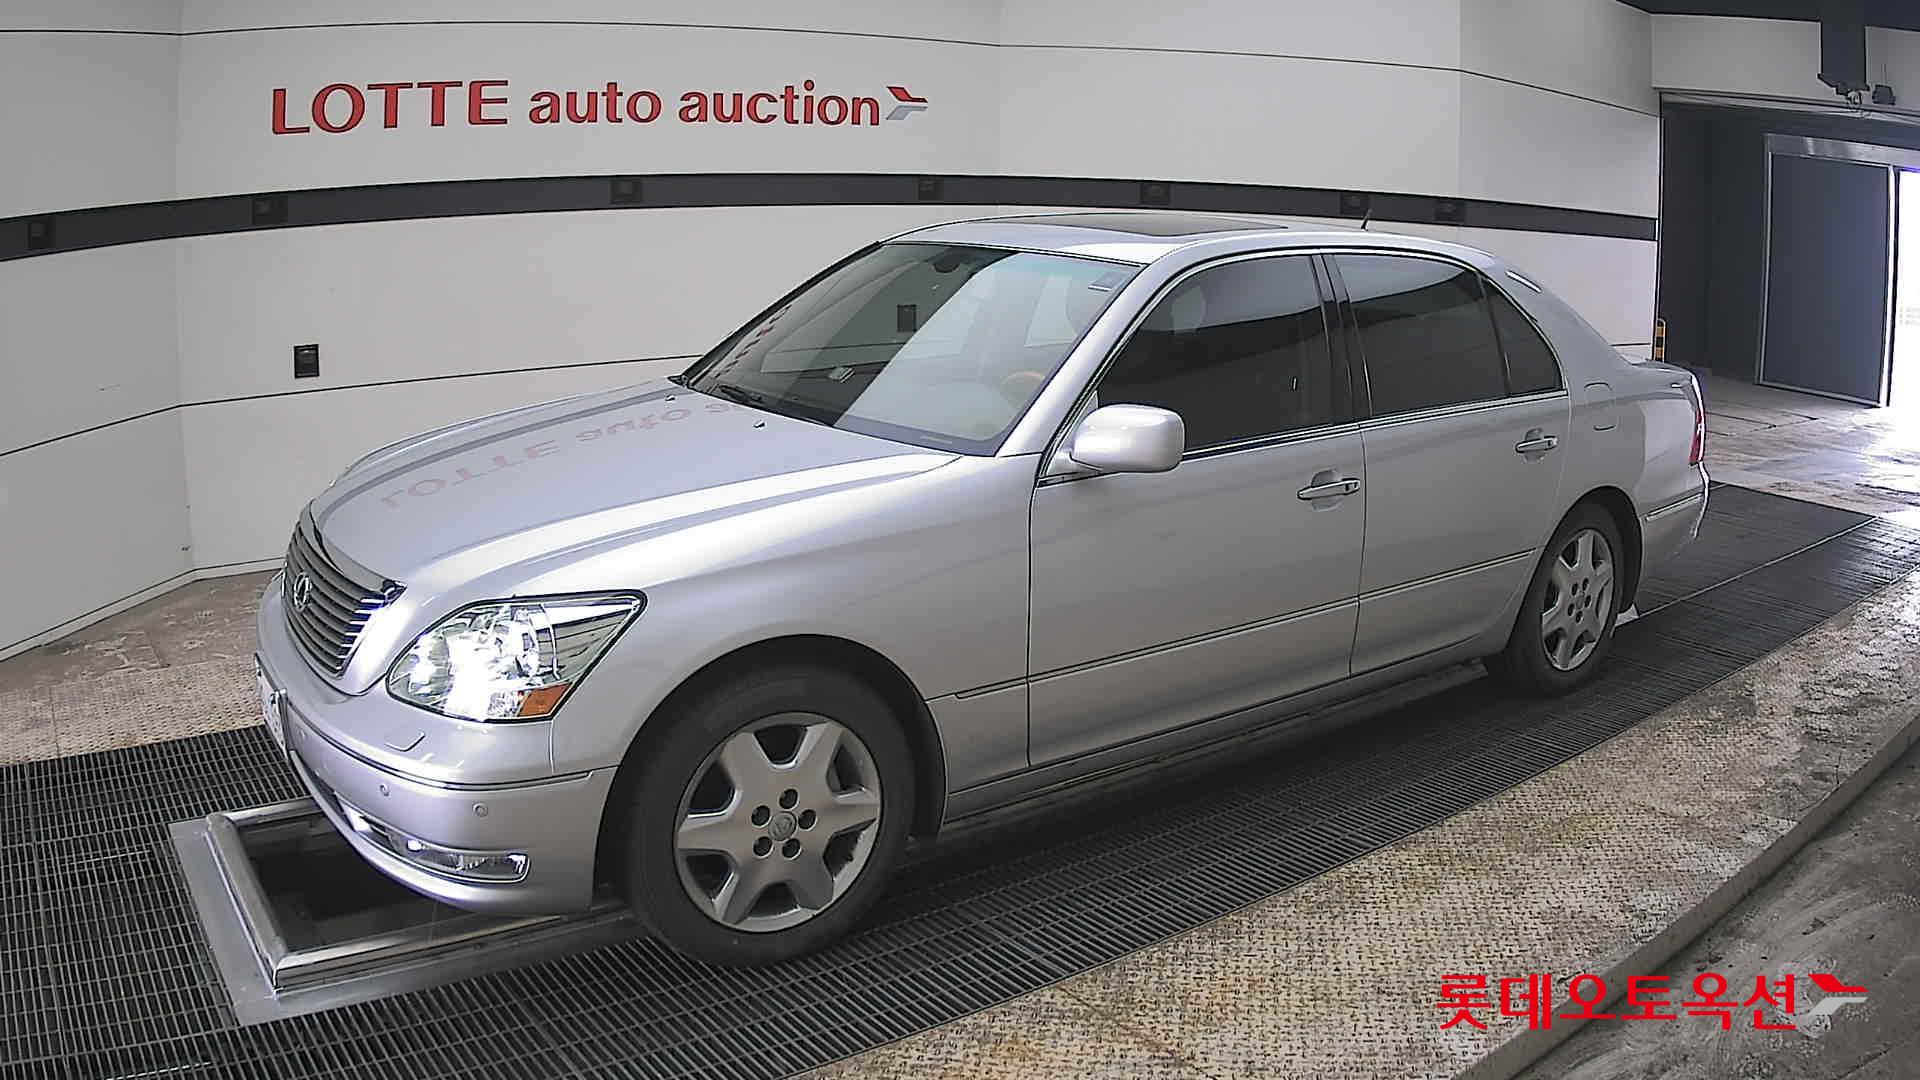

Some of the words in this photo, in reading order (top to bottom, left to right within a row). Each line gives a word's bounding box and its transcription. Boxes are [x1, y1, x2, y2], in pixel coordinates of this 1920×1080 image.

[272, 80, 507, 135] LOTTE
[528, 82, 663, 125] auto
[679, 80, 880, 127] auction
